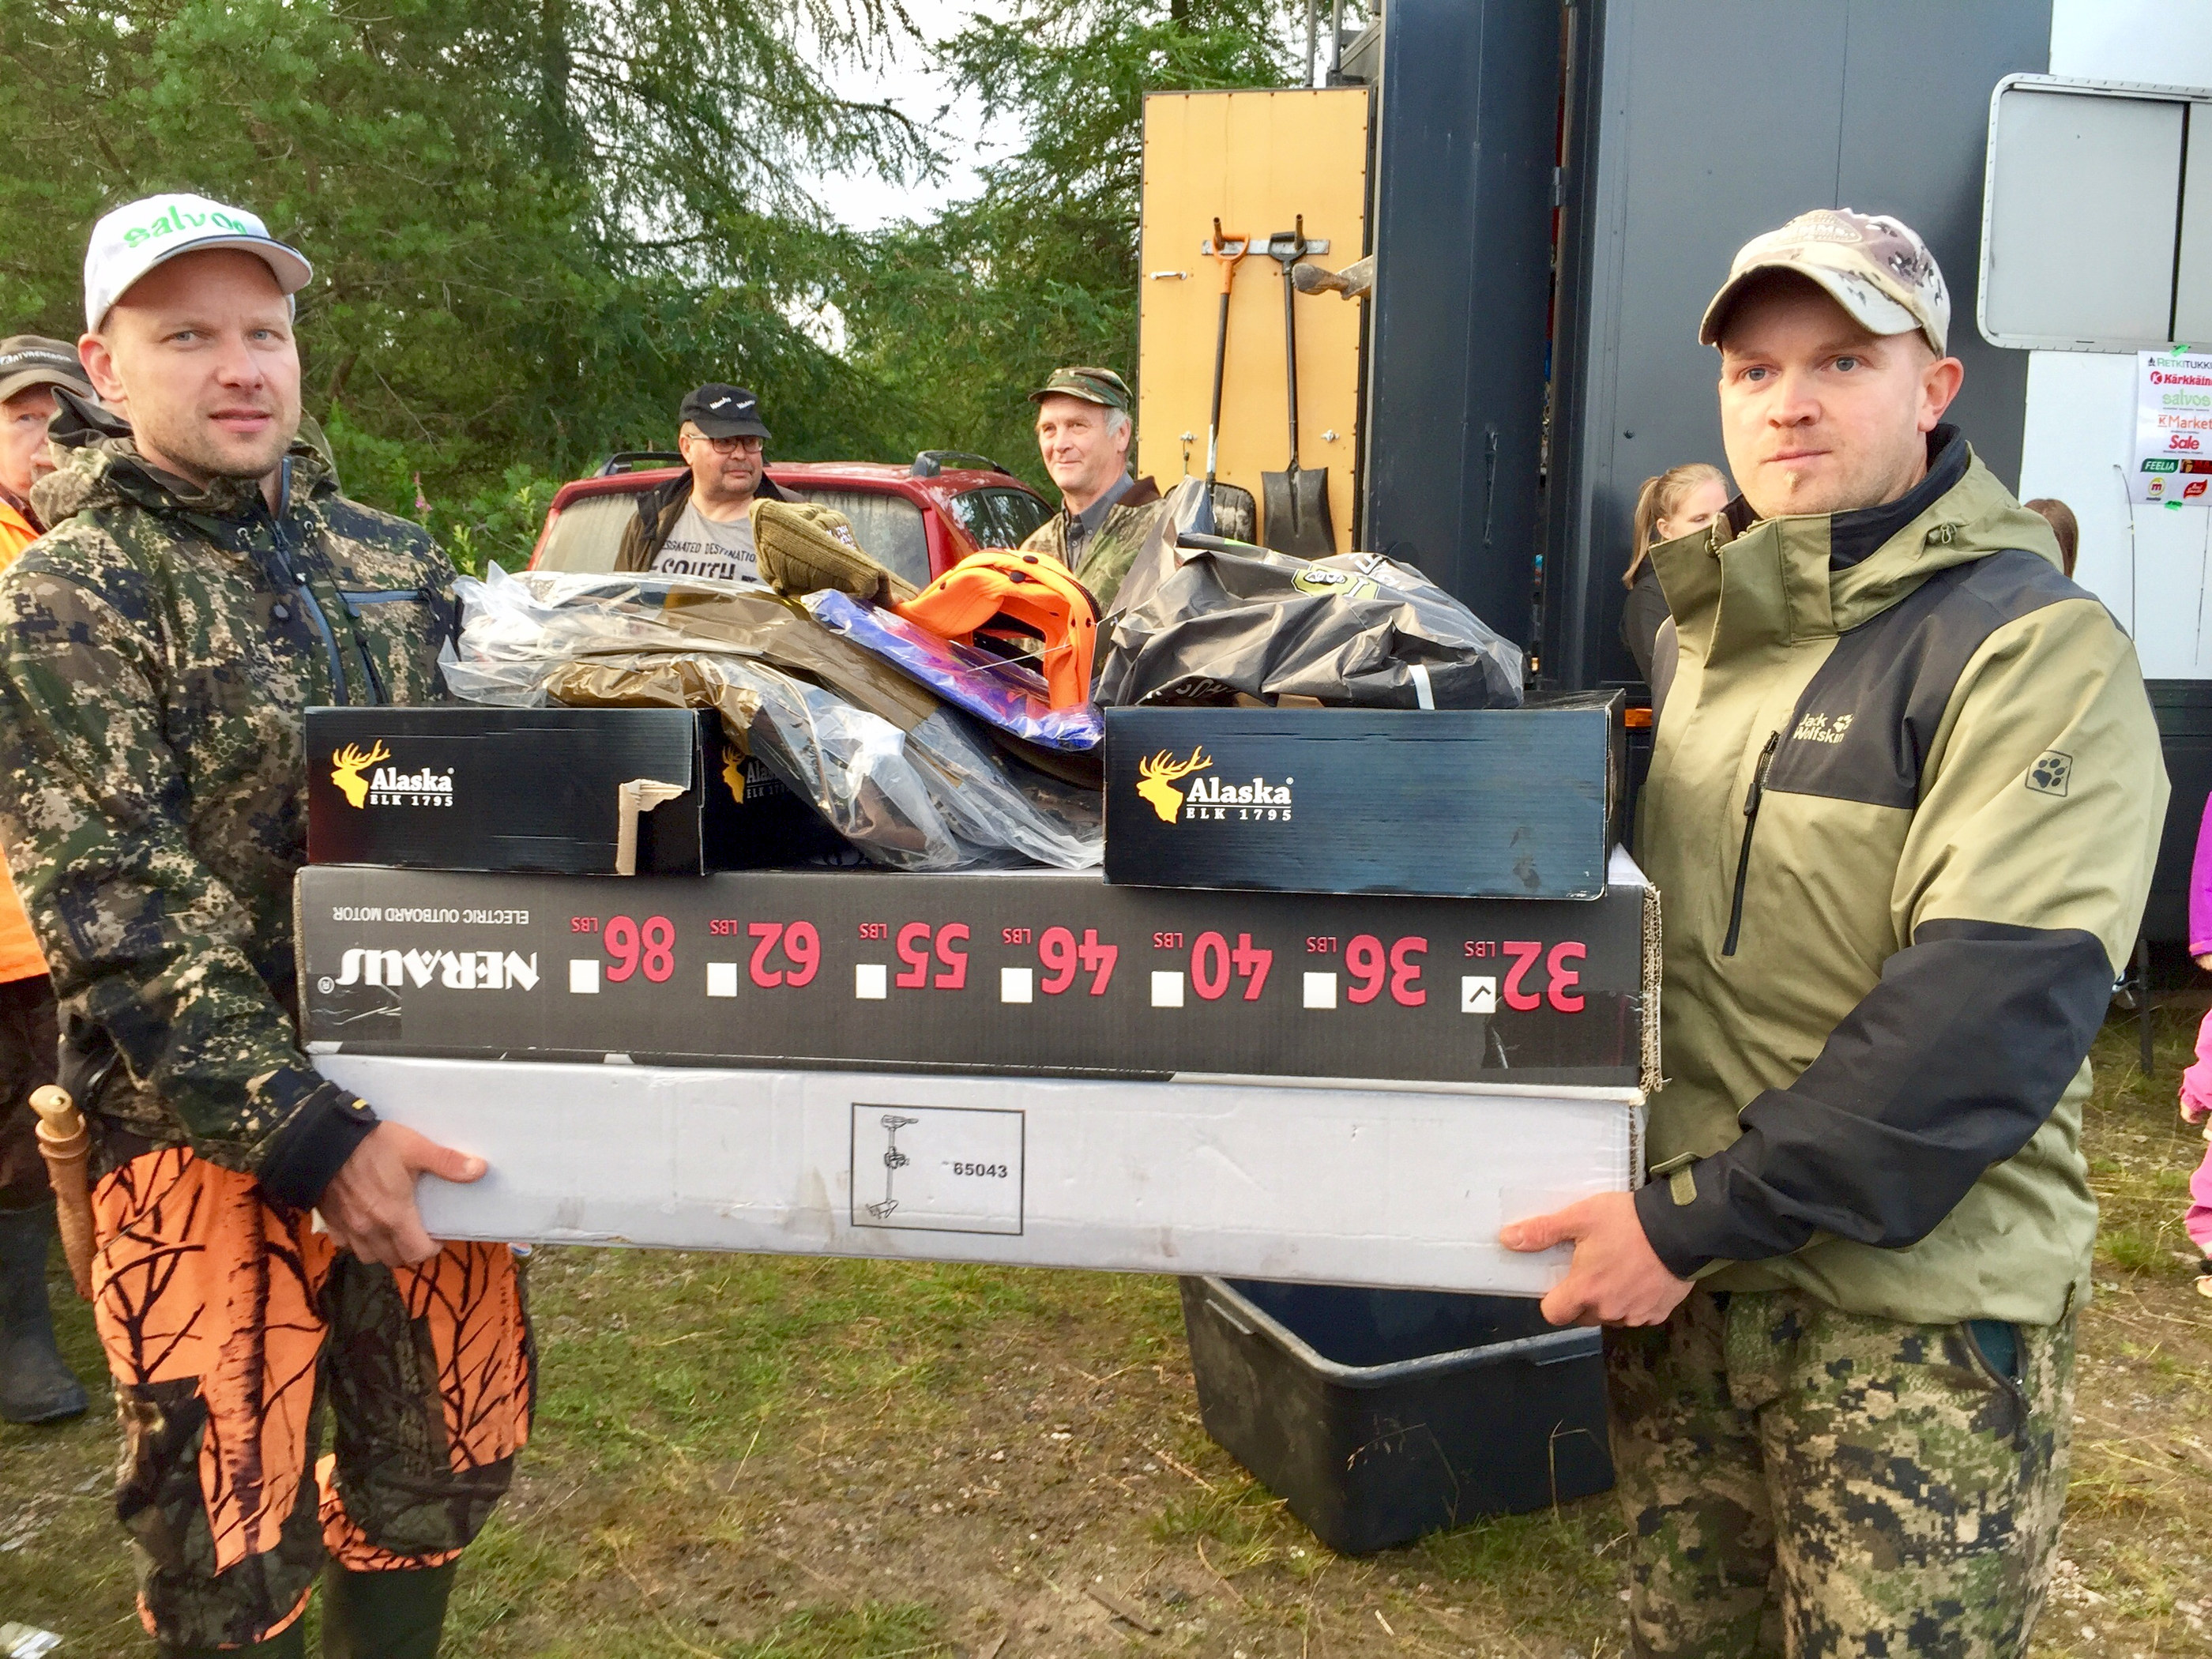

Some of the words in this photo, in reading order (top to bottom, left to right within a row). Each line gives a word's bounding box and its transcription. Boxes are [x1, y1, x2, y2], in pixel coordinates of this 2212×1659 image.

[2164, 374, 2212, 386] Kärkkäin
[2162, 388, 2211, 407] salvos
[2169, 434, 2200, 450] Sale
[2144, 461, 2175, 471] FEELIA
[705, 543, 756, 562] DESTINATIO
[1799, 713, 1828, 728] Jack
[1793, 726, 1845, 743] Wolfskin
[370, 766, 453, 792] Alaska
[1186, 777, 1292, 804] Alaska
[370, 794, 402, 805] ELK
[411, 796, 453, 807] 1795
[1186, 807, 1225, 819] ELK
[1240, 809, 1292, 822] 1795
[332, 906, 382, 921] MOTOR
[384, 907, 460, 924] OUTBOARD
[462, 909, 529, 925] ELECTRIC
[569, 916, 600, 935] LBS
[708, 918, 739, 937] LBS
[857, 922, 889, 941] LBS
[1000, 927, 1033, 946] LBS
[1151, 931, 1185, 950] LBS
[1305, 936, 1338, 954] LBS
[603, 914, 676, 984] 86
[747, 920, 822, 989] 62
[894, 921, 971, 991] 55
[1463, 941, 1497, 959] LBS
[1037, 925, 1119, 997] 46
[1190, 931, 1273, 1001] 40
[1345, 934, 1428, 1006] 36
[1502, 941, 1587, 1013] 32
[953, 1161, 1008, 1179] 65043
